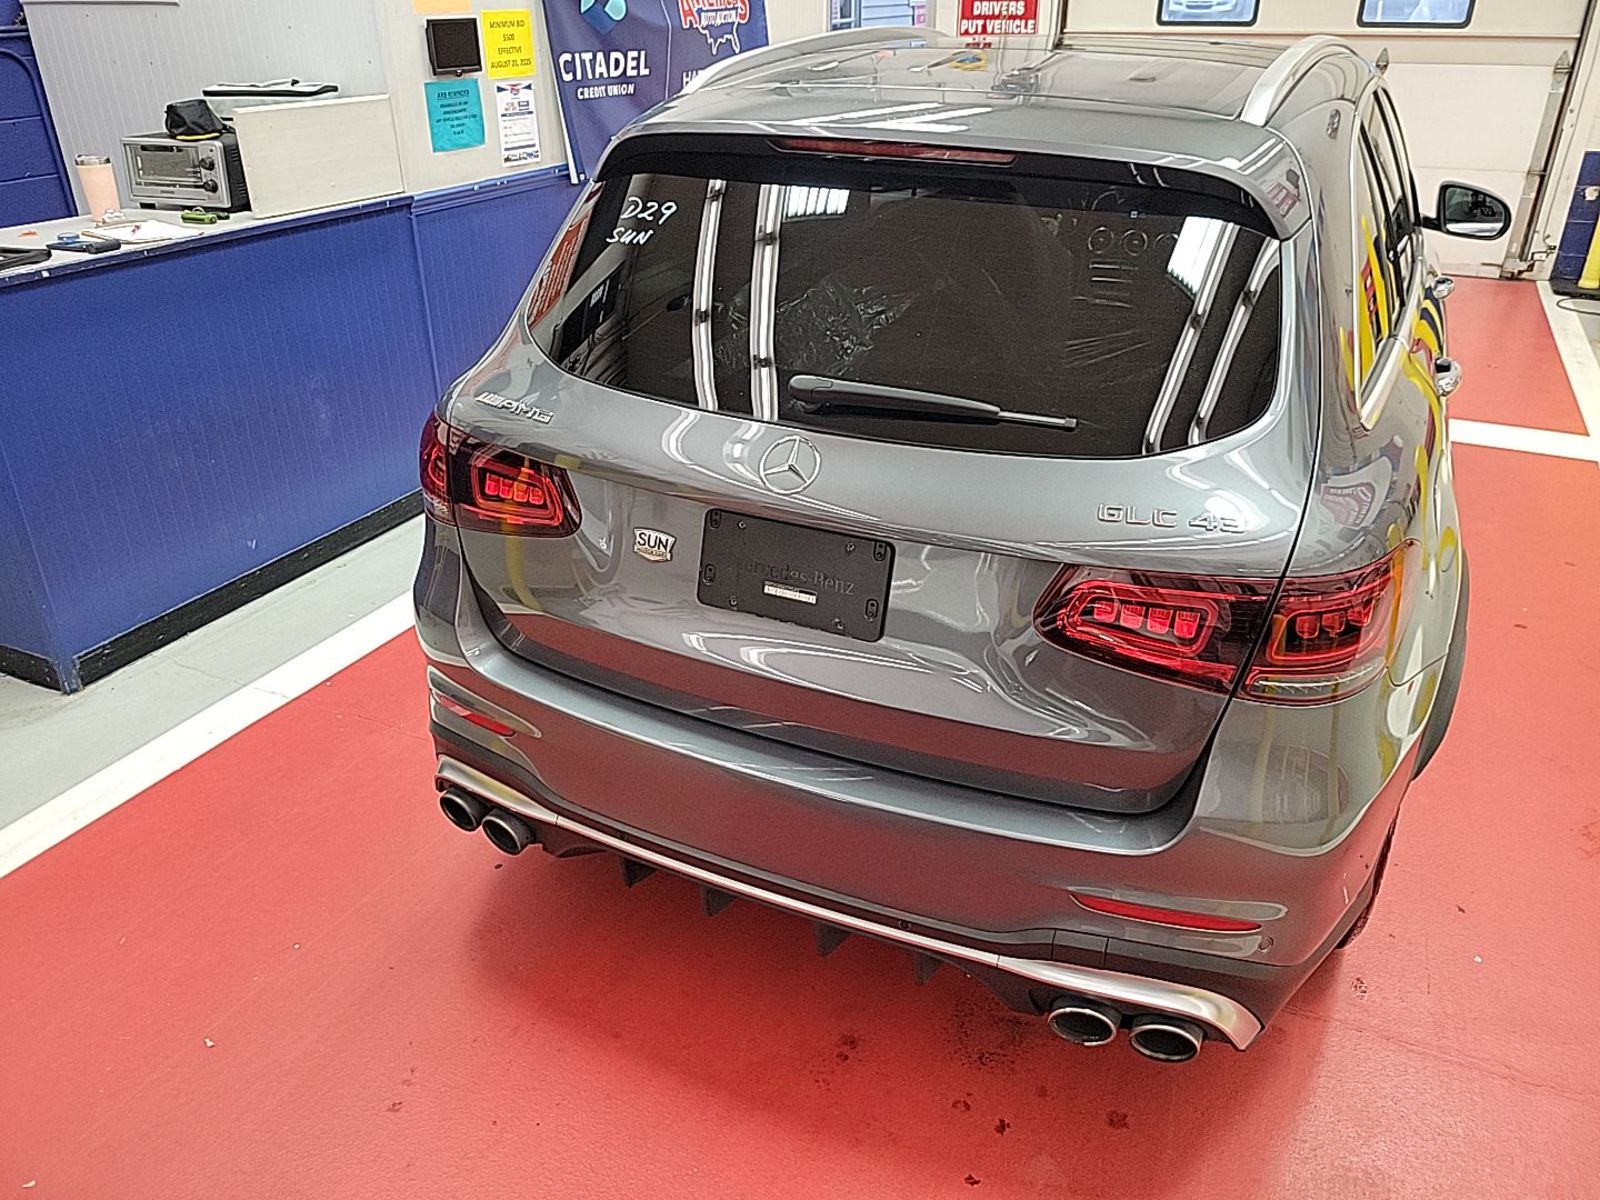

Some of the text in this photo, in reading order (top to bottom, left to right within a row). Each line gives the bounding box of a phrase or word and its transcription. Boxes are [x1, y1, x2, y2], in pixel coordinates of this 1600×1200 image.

[972, 1, 1026, 16] DRIVERS
[490, 20, 515, 28] MINIMUM
[960, 19, 1036, 34] PUT VEHICLE
[498, 46, 522, 55] EFFECTIVE
[491, 60, 511, 69] AUGUST
[559, 50, 650, 82] CITADEL
[577, 83, 635, 99] CREDIT UNION
[620, 196, 678, 225] D29
[605, 227, 654, 245] SUN
[1097, 503, 1246, 534] GLC 43
[637, 532, 670, 552] SUN
[813, 570, 857, 596] Benz
